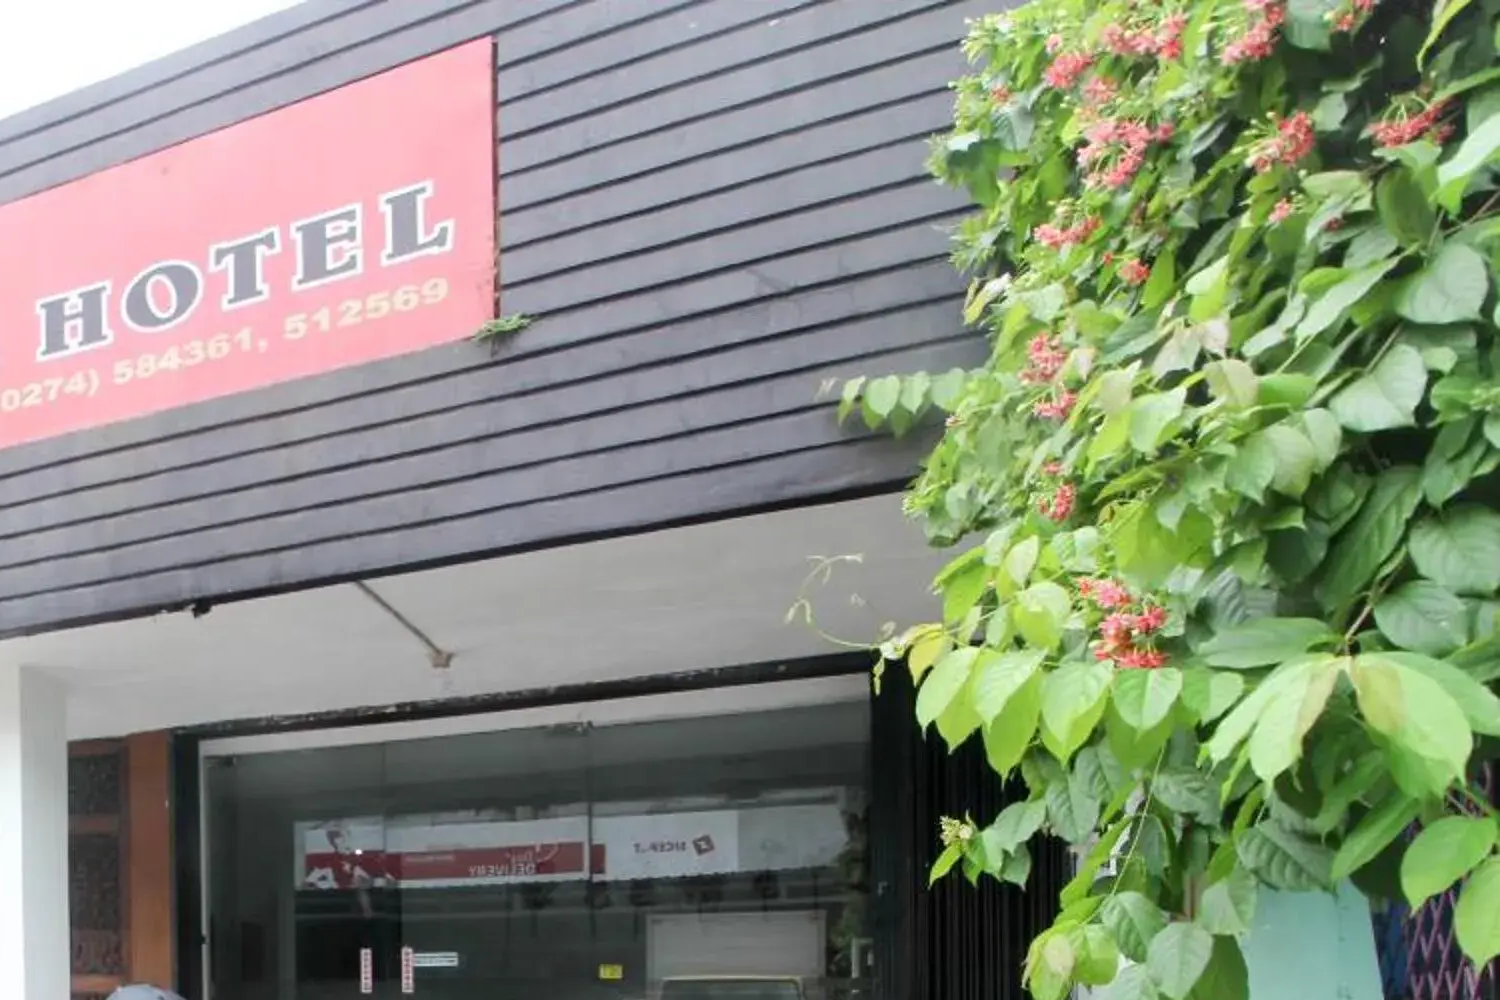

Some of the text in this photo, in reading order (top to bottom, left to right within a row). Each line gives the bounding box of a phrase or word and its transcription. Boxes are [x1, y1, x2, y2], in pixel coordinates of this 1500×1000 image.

[36, 180, 454, 362] HOTEL
[112, 327, 268, 385] 584361,
[283, 277, 449, 340] 512569
